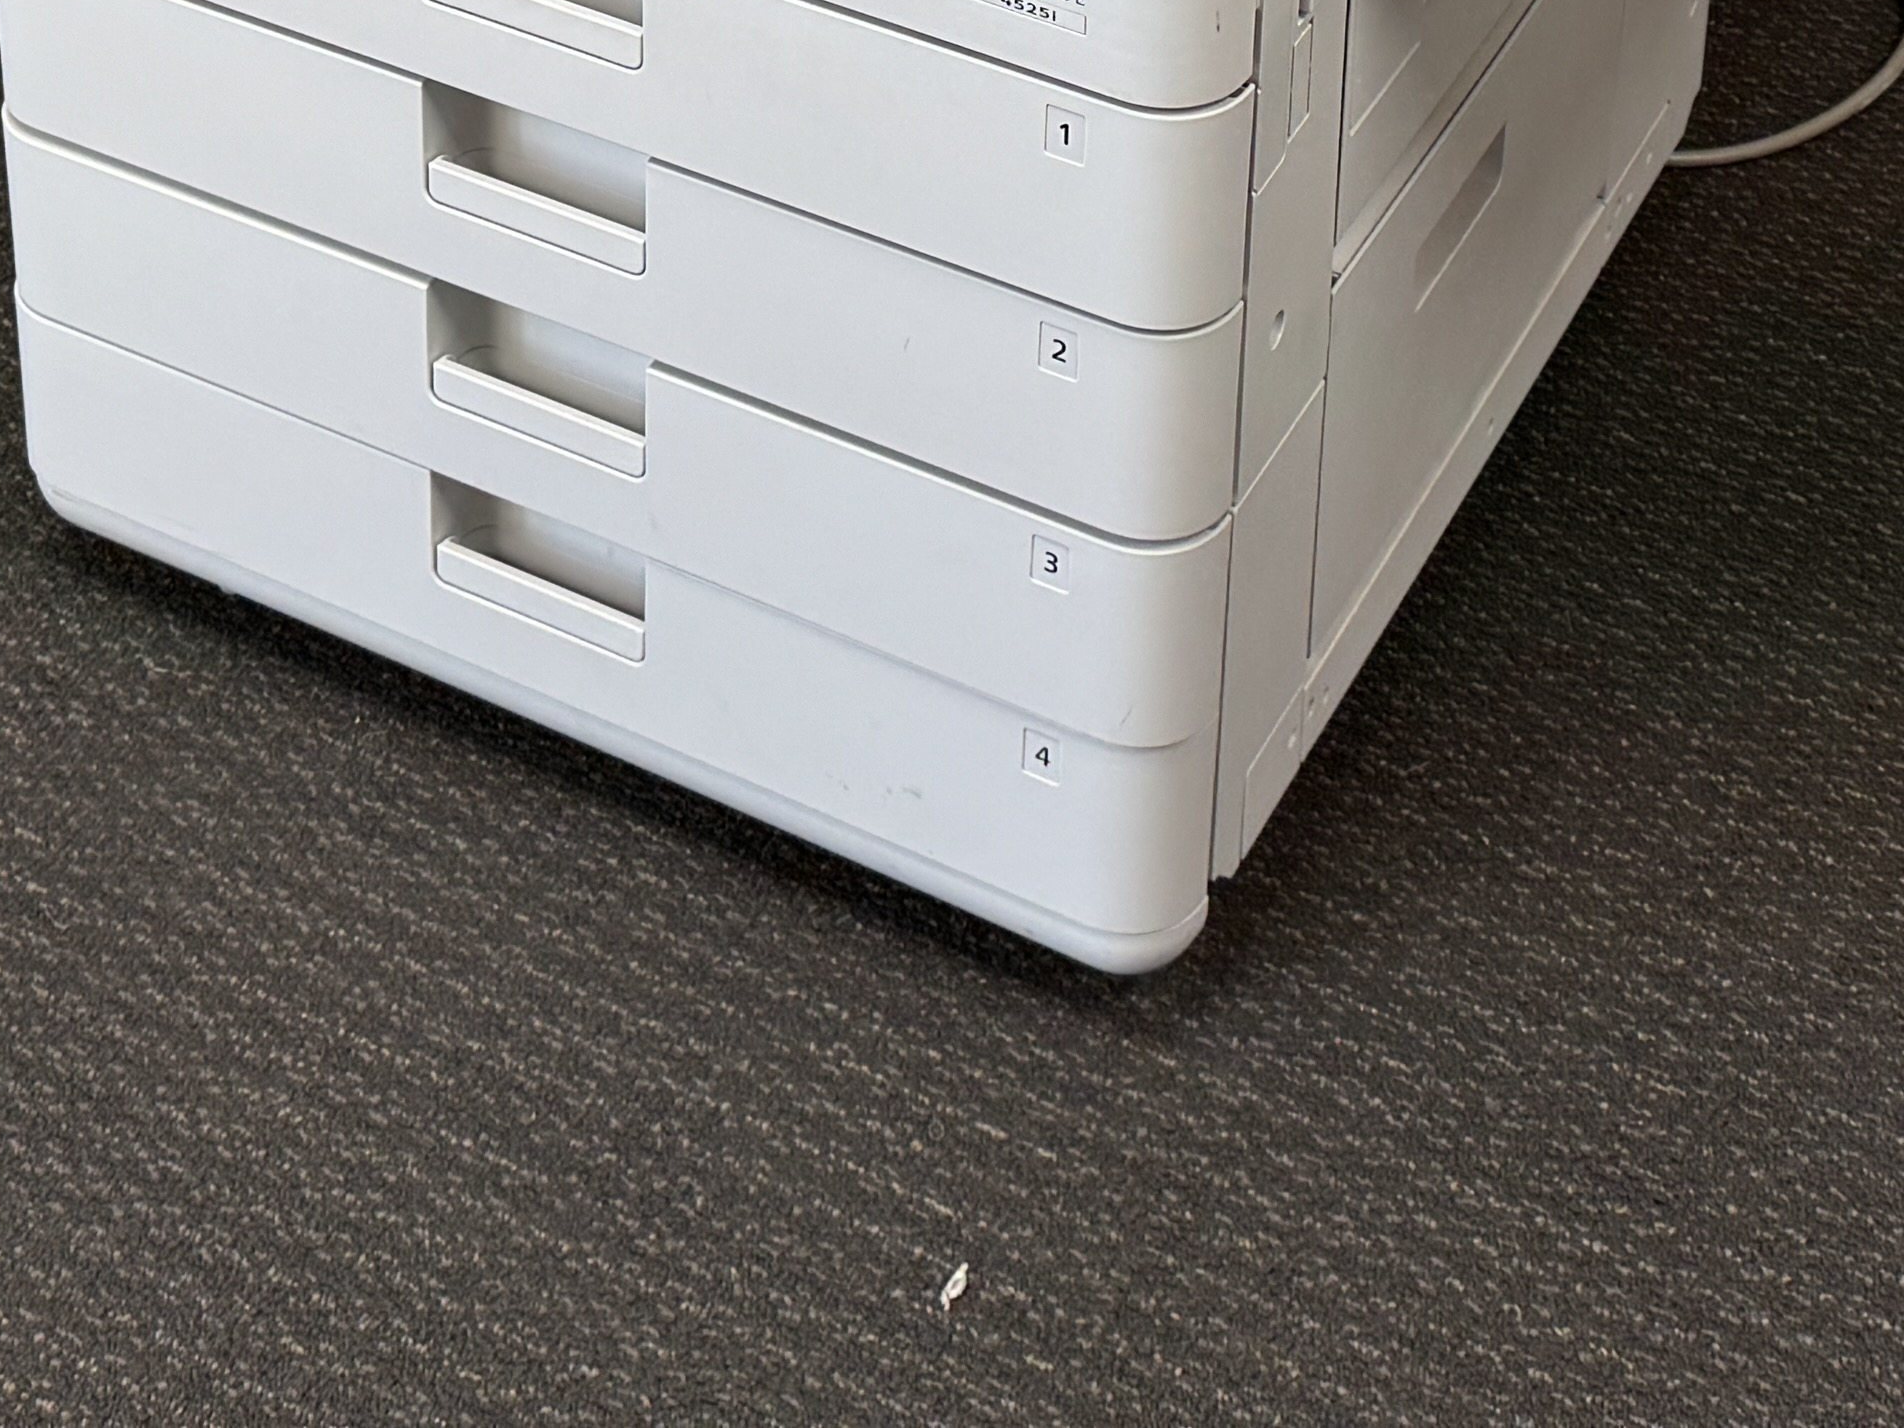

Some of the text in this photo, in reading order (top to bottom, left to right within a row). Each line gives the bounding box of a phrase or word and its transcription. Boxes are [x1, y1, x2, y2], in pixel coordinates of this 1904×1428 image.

[1059, 123, 1069, 146] 1
[1052, 338, 1067, 363] 2
[1044, 551, 1058, 573] 3
[1035, 746, 1051, 767] 4
